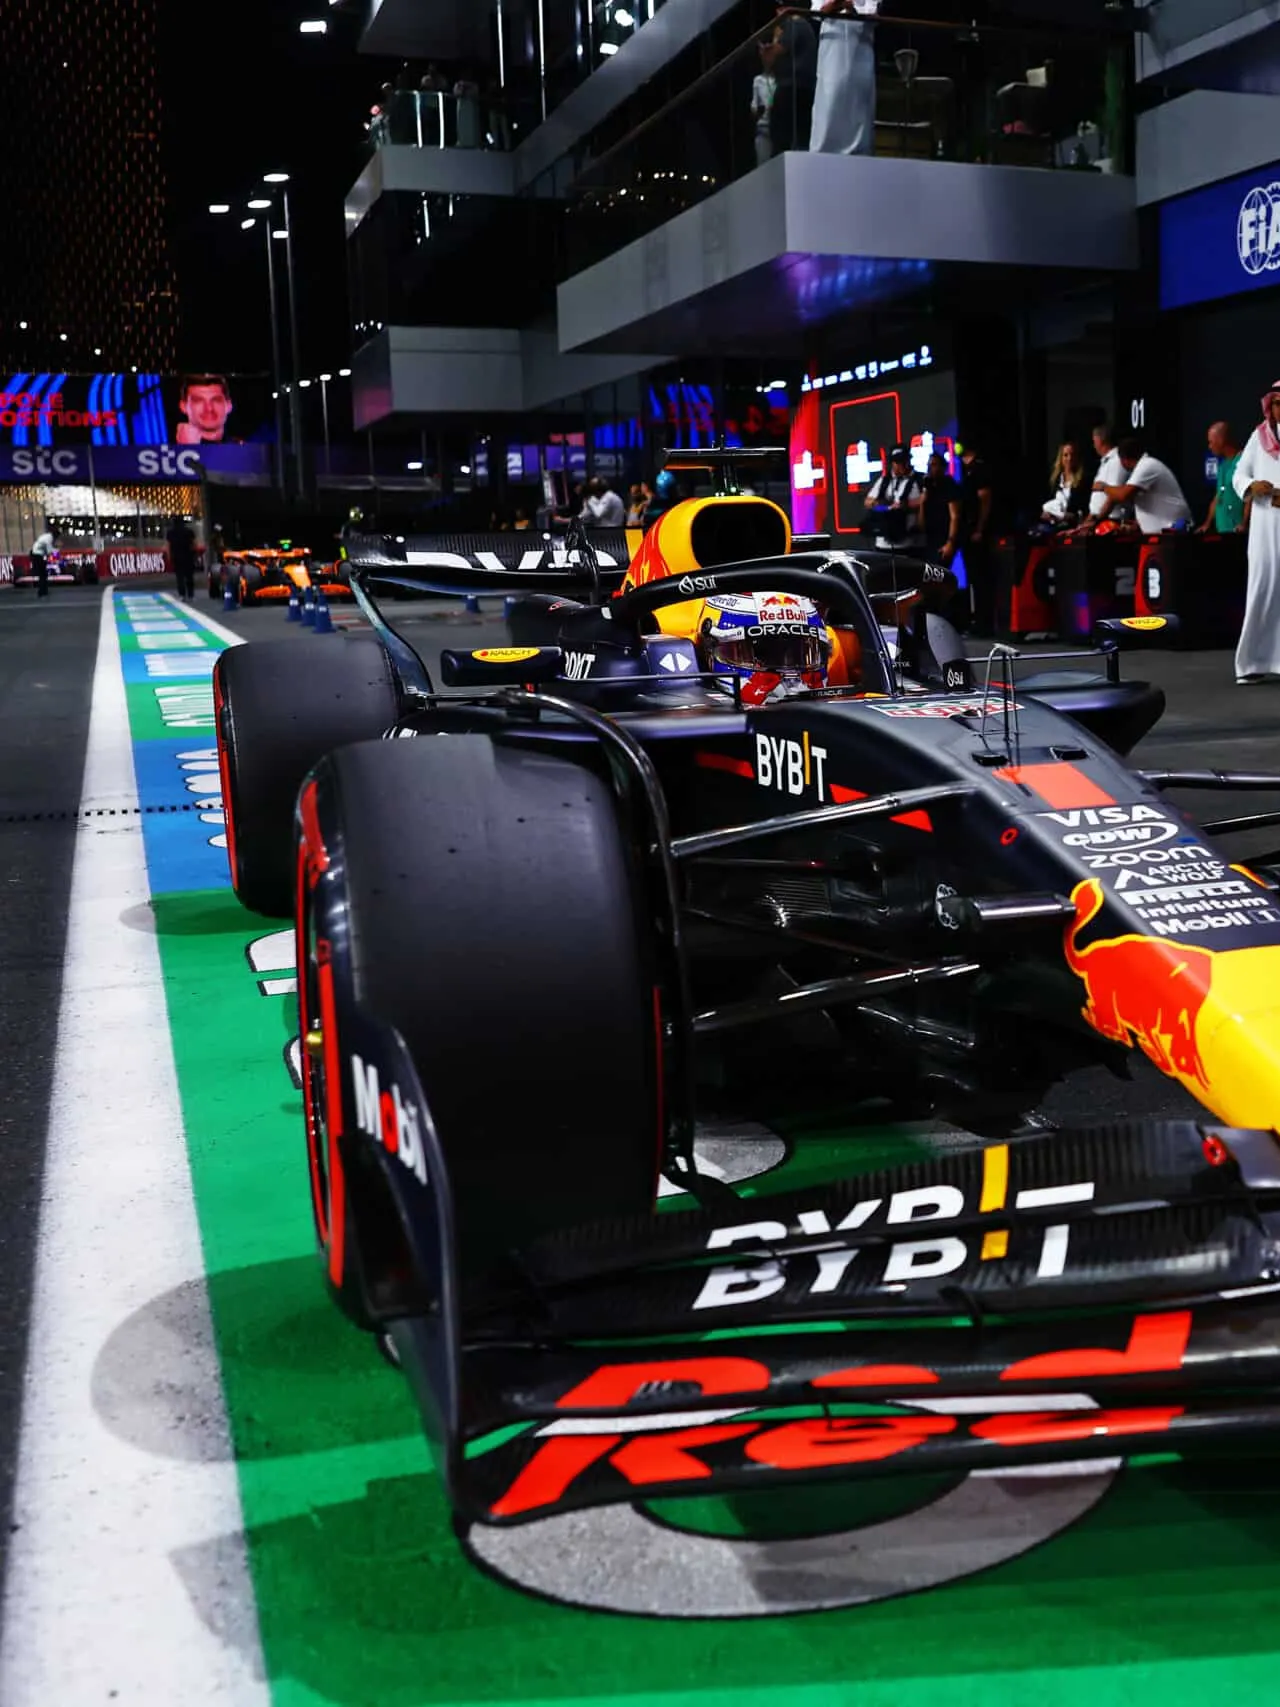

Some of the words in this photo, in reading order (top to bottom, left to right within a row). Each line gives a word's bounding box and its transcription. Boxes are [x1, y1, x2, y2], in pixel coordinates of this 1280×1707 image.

[1131, 398, 1145, 429] 01
[110, 553, 136, 577] QATAR
[759, 609, 784, 621] Red
[785, 607, 807, 621] Bull
[747, 624, 818, 637] ORACLE
[756, 731, 828, 802] BYBIT
[1036, 804, 1167, 827] VISA
[1062, 825, 1152, 848] CDW
[1081, 846, 1213, 868] zoom
[1147, 860, 1225, 877] ARCTIC
[1161, 869, 1225, 884] WOLF
[1118, 880, 1254, 905] PIRELLI
[1149, 910, 1252, 936] Mobil
[692, 1143, 1095, 1310] BYBIT
